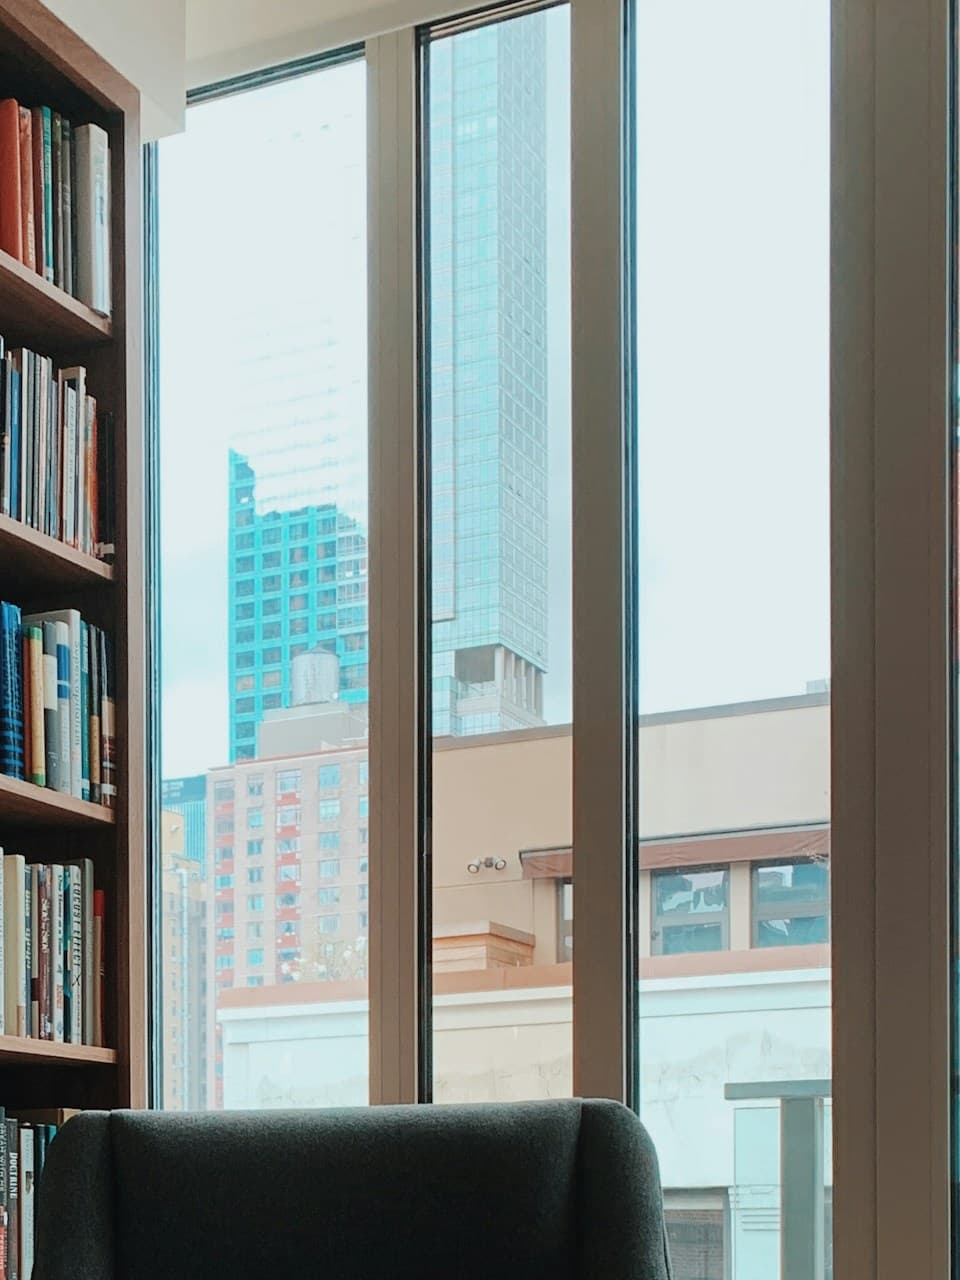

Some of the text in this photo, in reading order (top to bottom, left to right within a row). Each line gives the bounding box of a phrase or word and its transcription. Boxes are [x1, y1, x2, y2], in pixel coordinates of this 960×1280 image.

[73, 883, 81, 968] LOCUST EFFECT
[0, 1180, 5, 1192] ME
[9, 1152, 18, 1199] DOCTRINE
